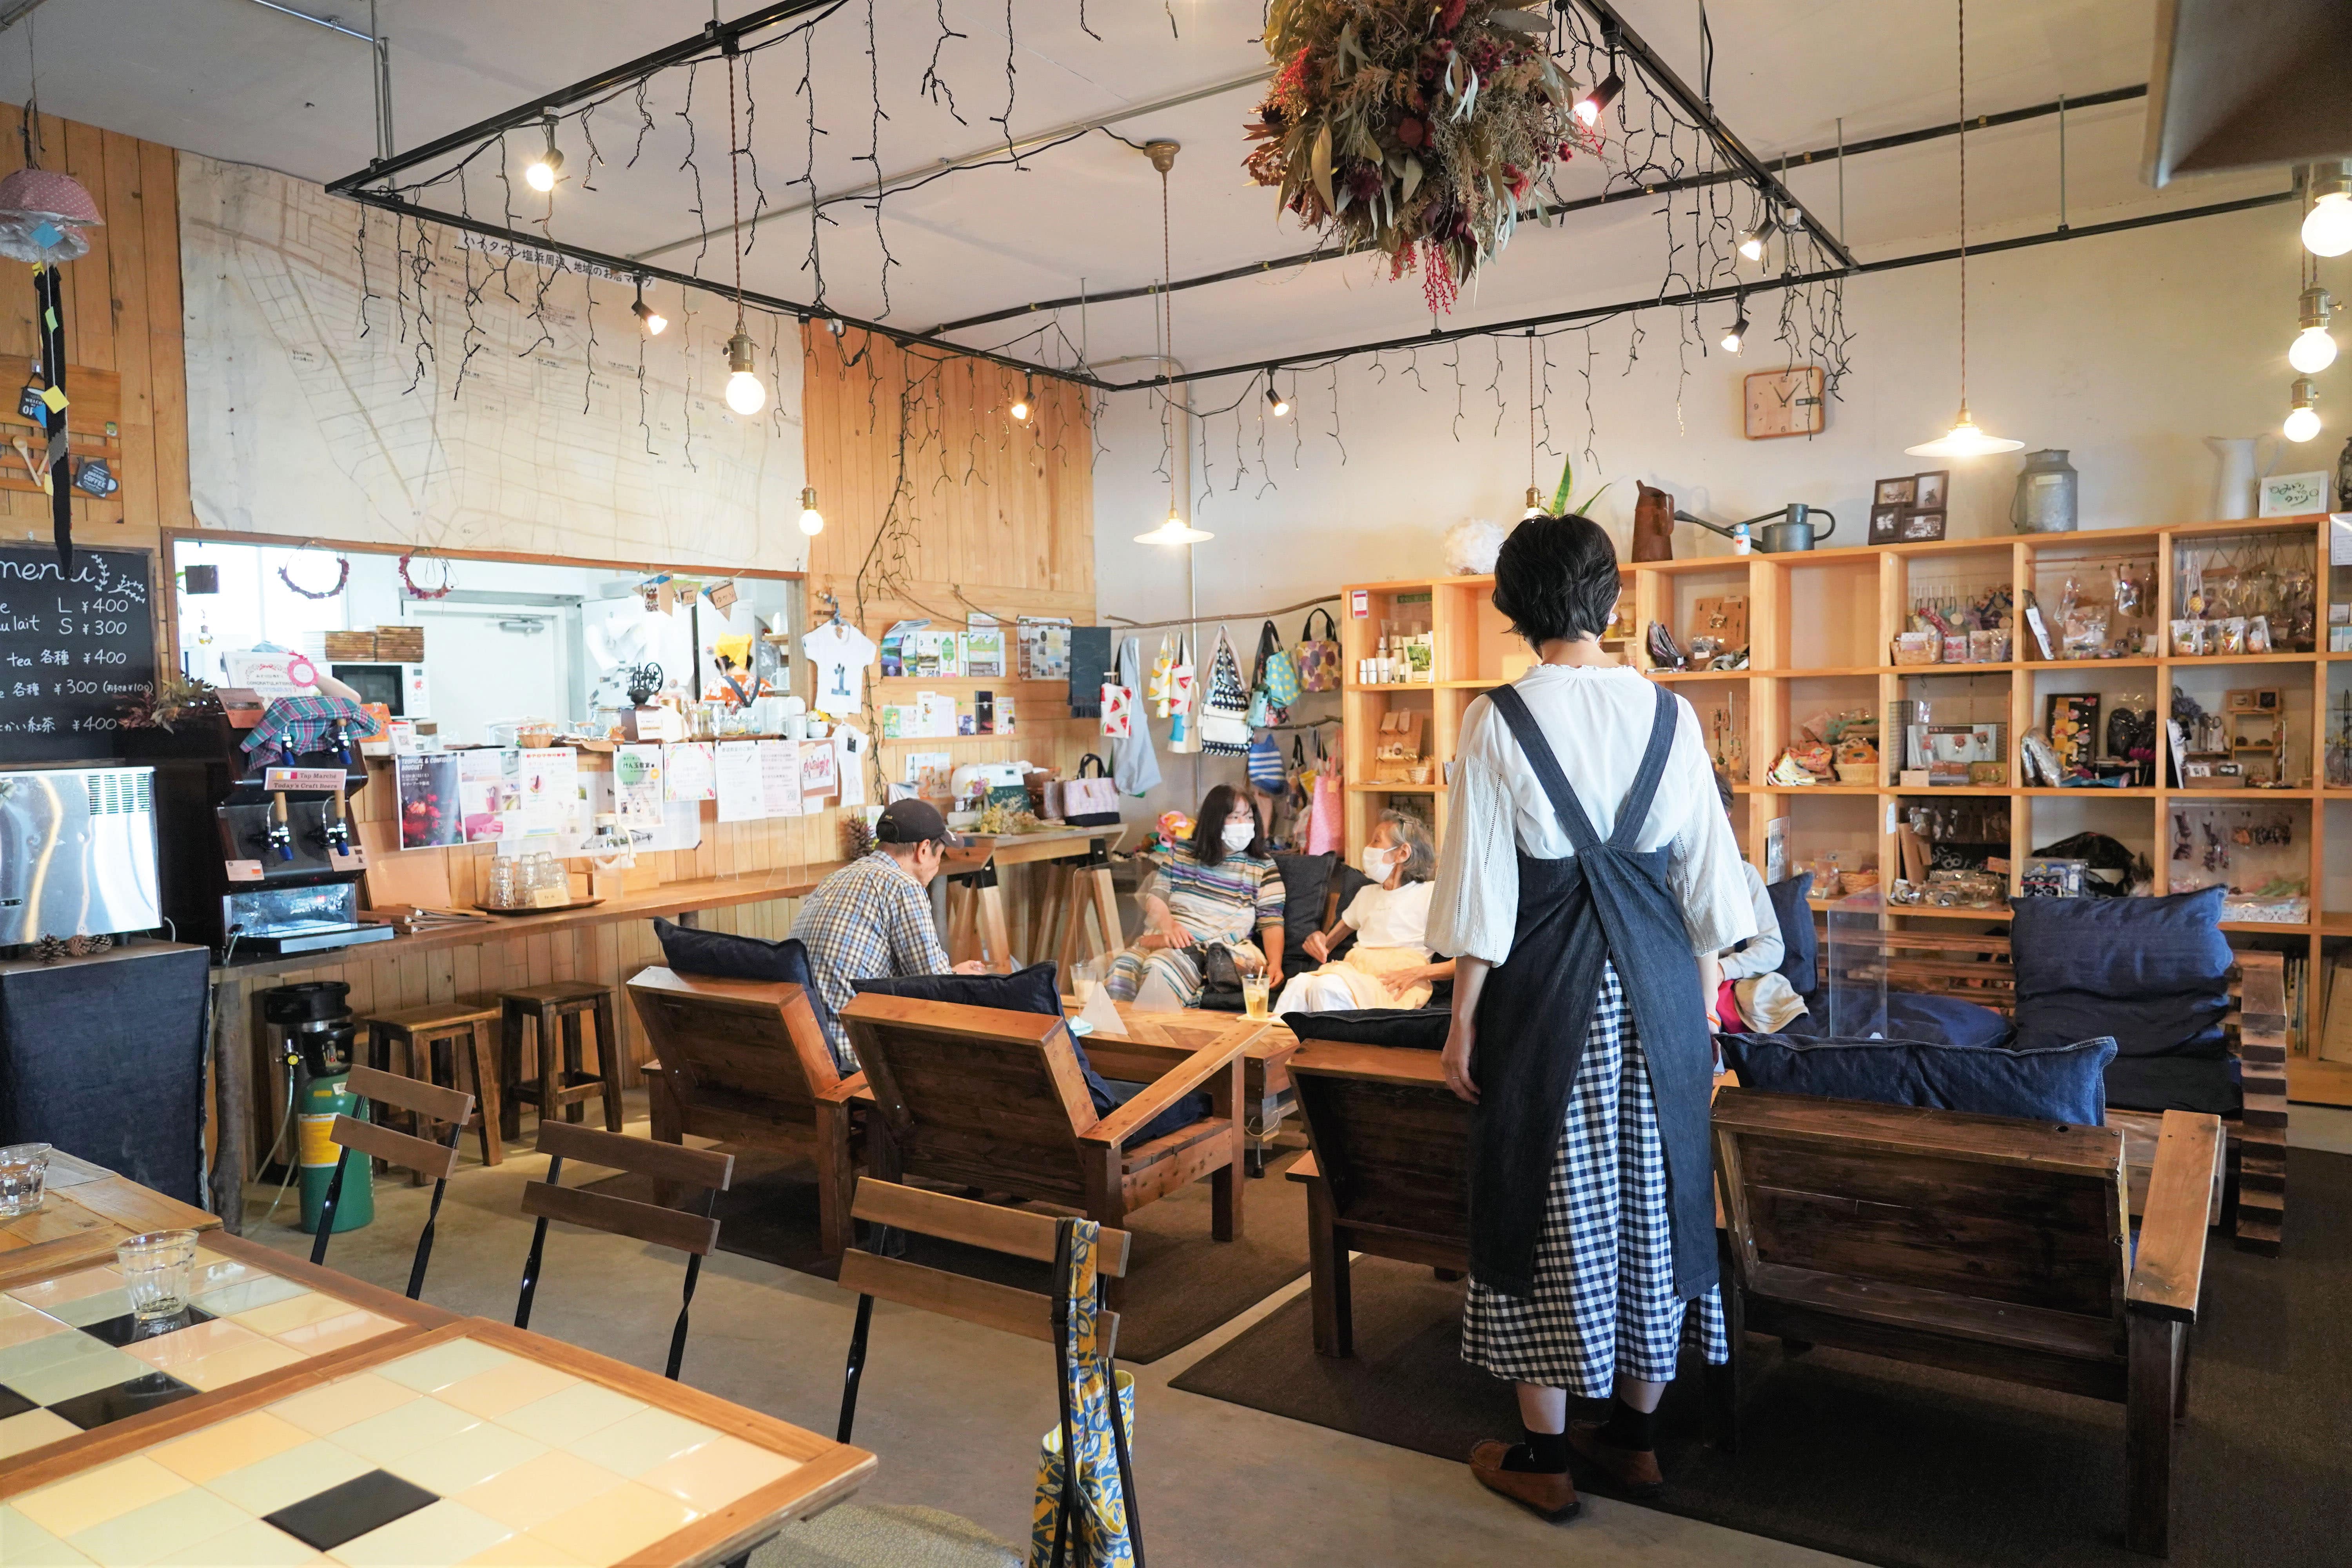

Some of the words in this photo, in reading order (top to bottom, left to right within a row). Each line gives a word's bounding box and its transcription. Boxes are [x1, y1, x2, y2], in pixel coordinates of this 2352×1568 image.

[58, 597, 73, 613] L
[82, 598, 129, 614] ¥400
[14, 614, 40, 632] lait
[59, 618, 73, 635] S
[83, 620, 127, 635] ¥300
[6, 652, 33, 667] tea
[40, 648, 70, 666] 各種
[83, 649, 127, 665] ¥400
[13, 682, 40, 697] 各種
[54, 679, 97, 696] ¥300
[72, 716, 117, 732] ¥400
